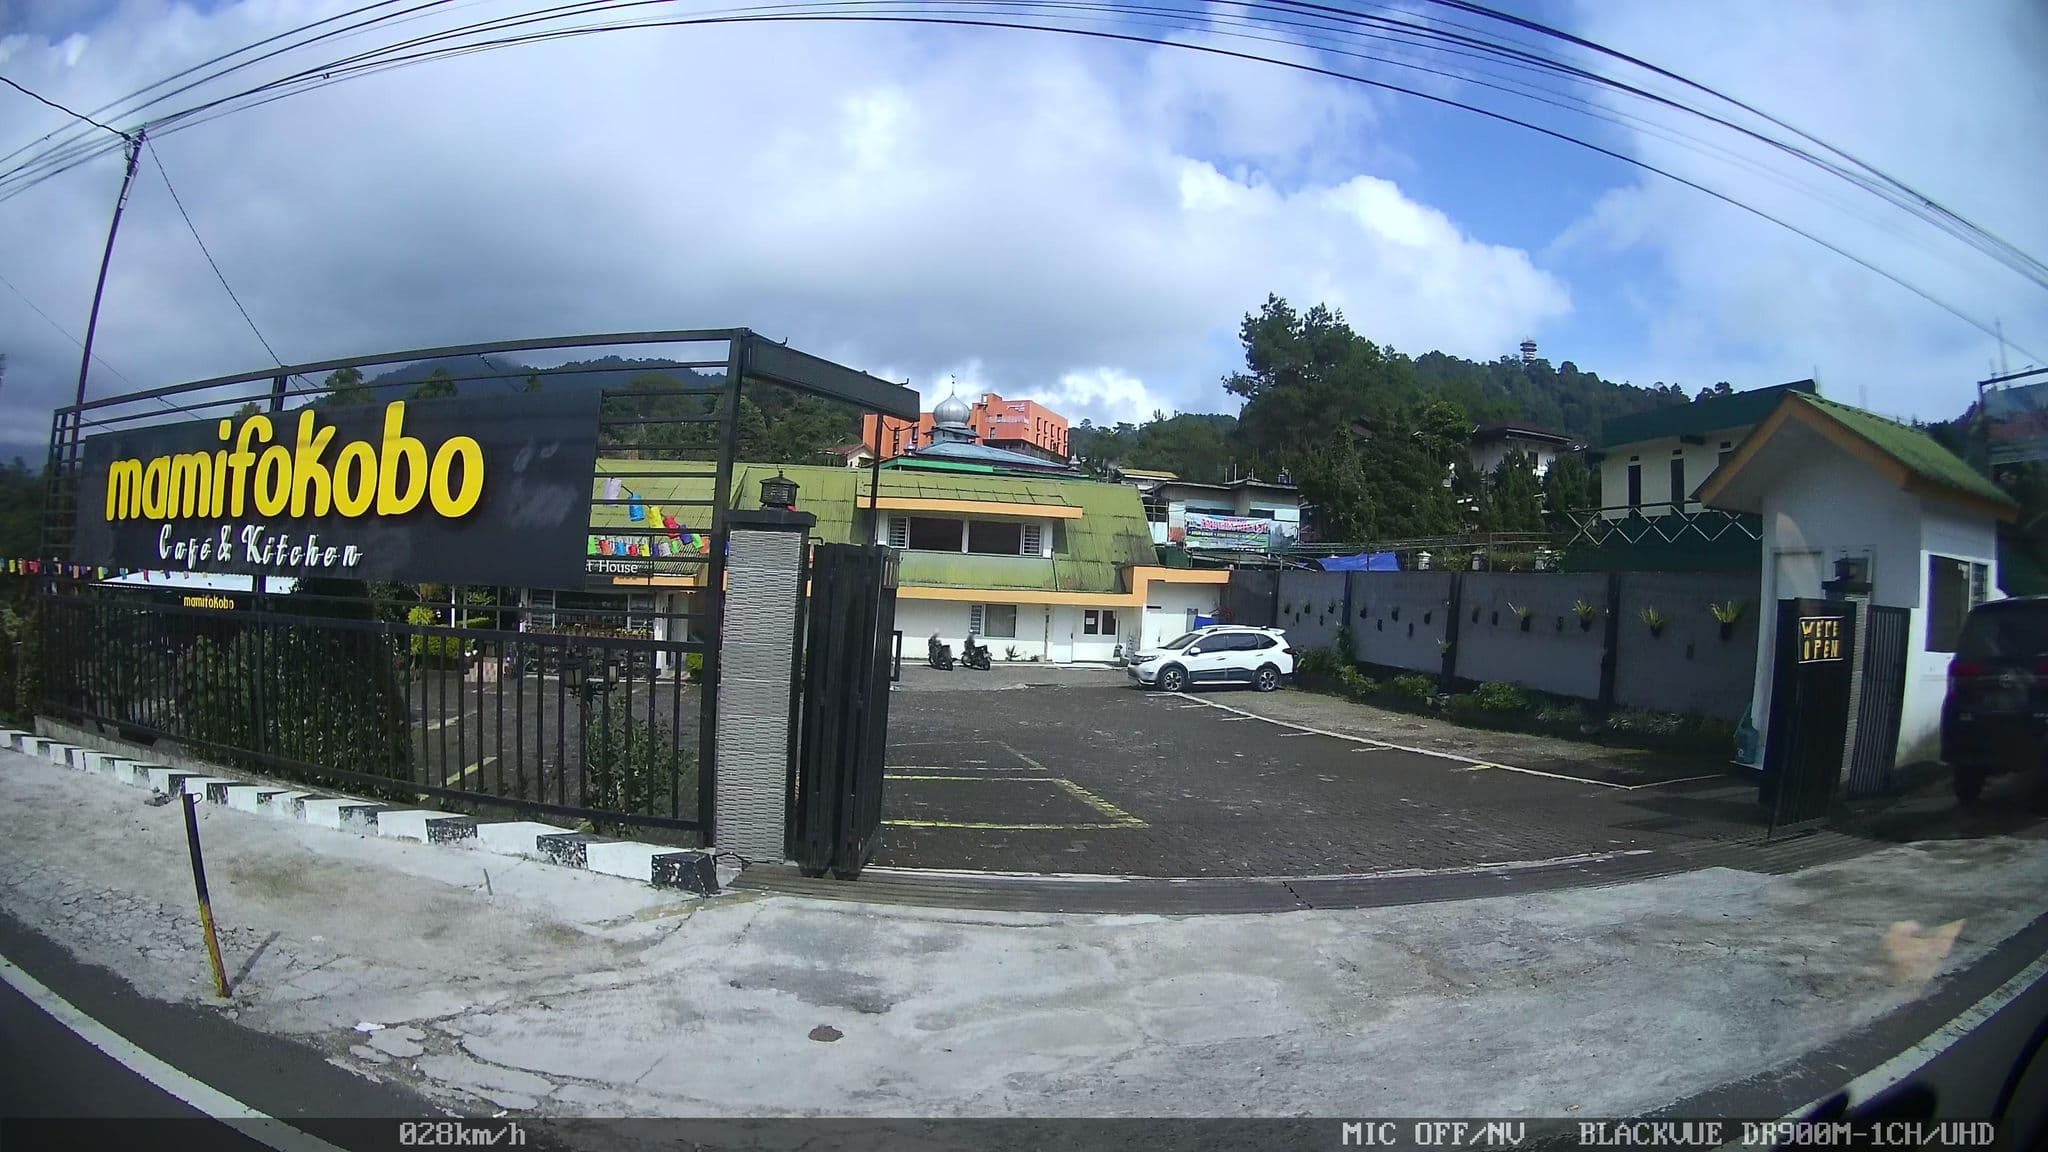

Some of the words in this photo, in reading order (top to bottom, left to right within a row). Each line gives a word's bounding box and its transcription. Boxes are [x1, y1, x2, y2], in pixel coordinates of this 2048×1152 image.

[105, 401, 486, 521] mamifokobo
[158, 524, 213, 569] Café
[217, 525, 233, 562] &
[241, 525, 364, 567] Kitchen
[598, 560, 638, 573] House
[1804, 639, 1839, 660] OPEN
